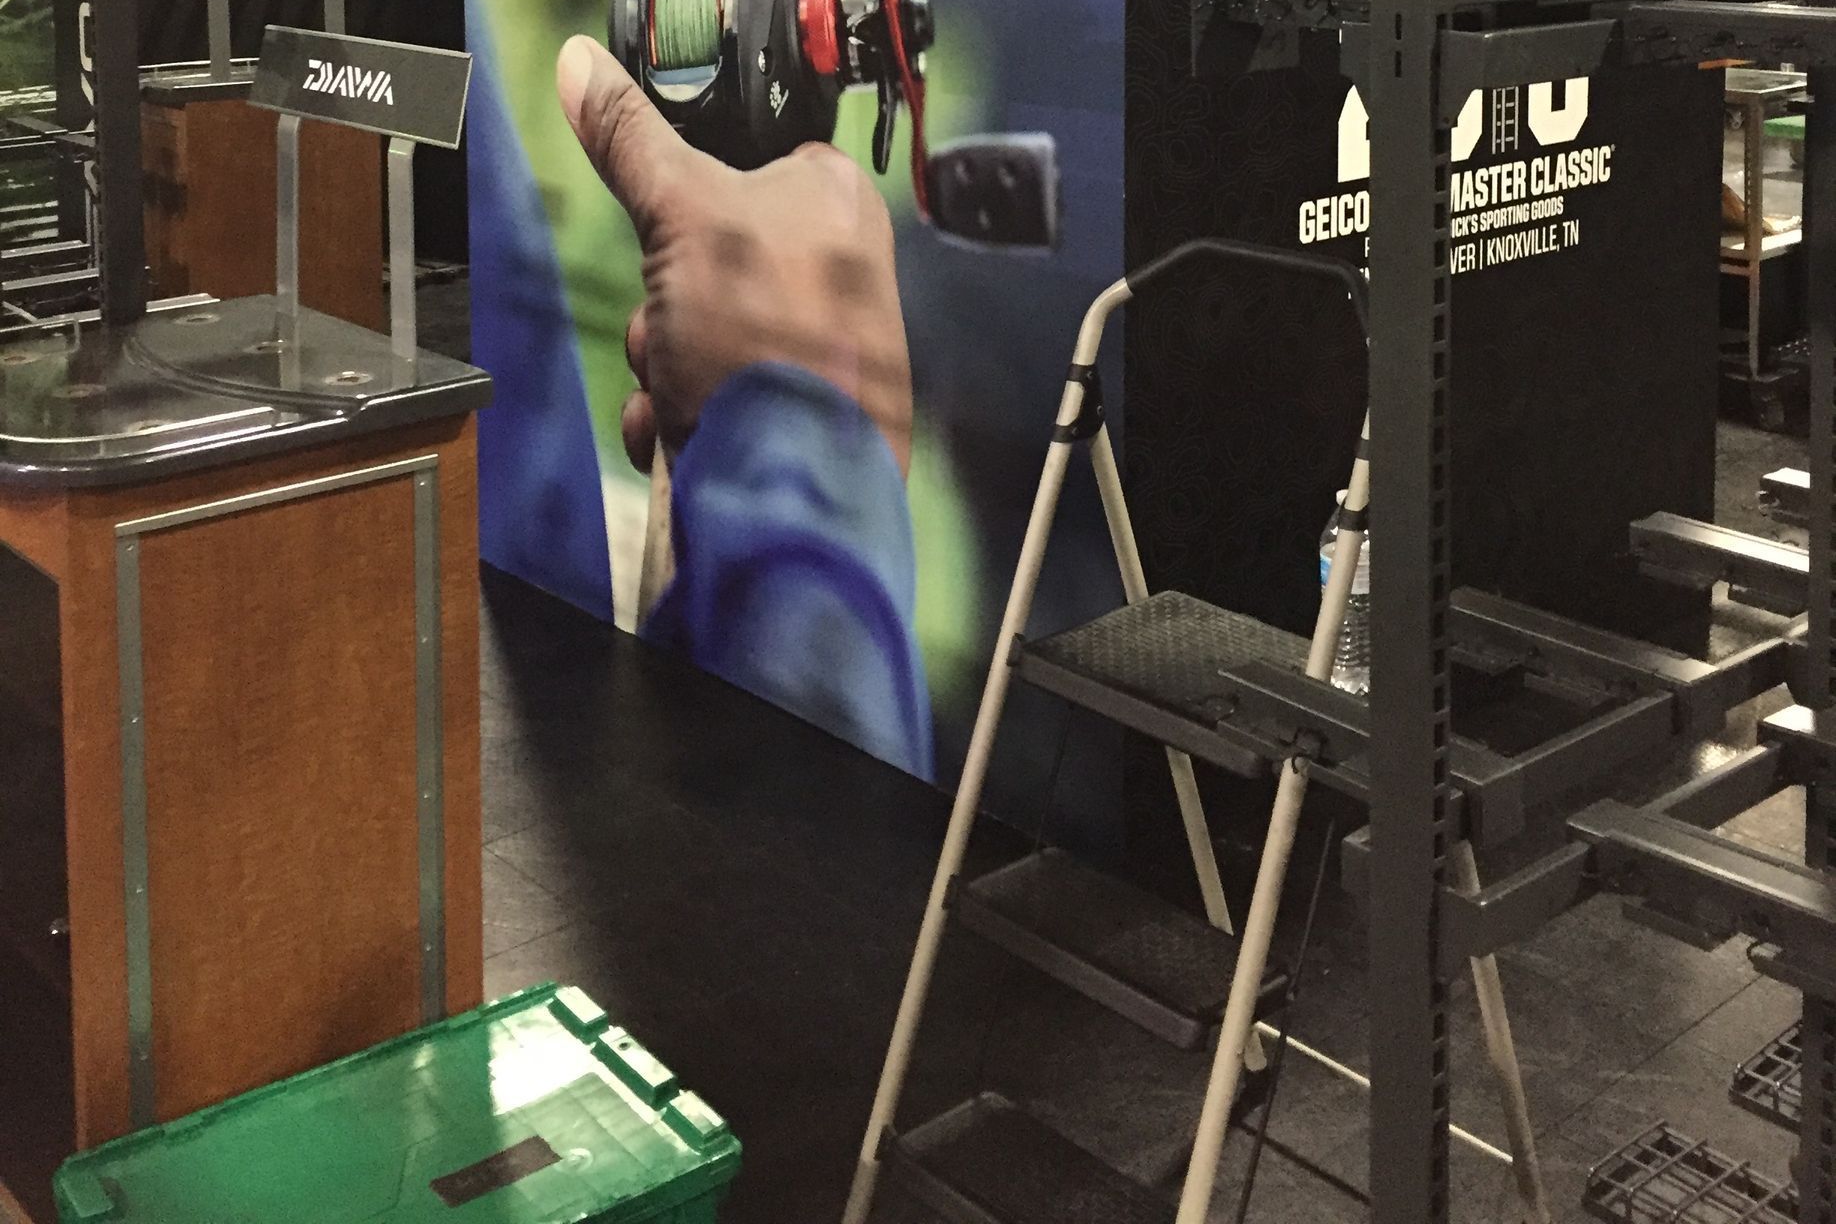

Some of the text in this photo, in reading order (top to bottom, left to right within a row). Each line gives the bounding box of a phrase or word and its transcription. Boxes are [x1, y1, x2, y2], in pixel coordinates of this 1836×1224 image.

[302, 59, 394, 106] DAIWA
[1299, 145, 1611, 245] GEICO MASTER CLASSIC
[1451, 196, 1564, 239] ICK'S SPORTING GOODS
[1450, 243, 1476, 275] VER
[1487, 224, 1560, 266] KNOXVILLE,
[1563, 219, 1580, 248] TN
